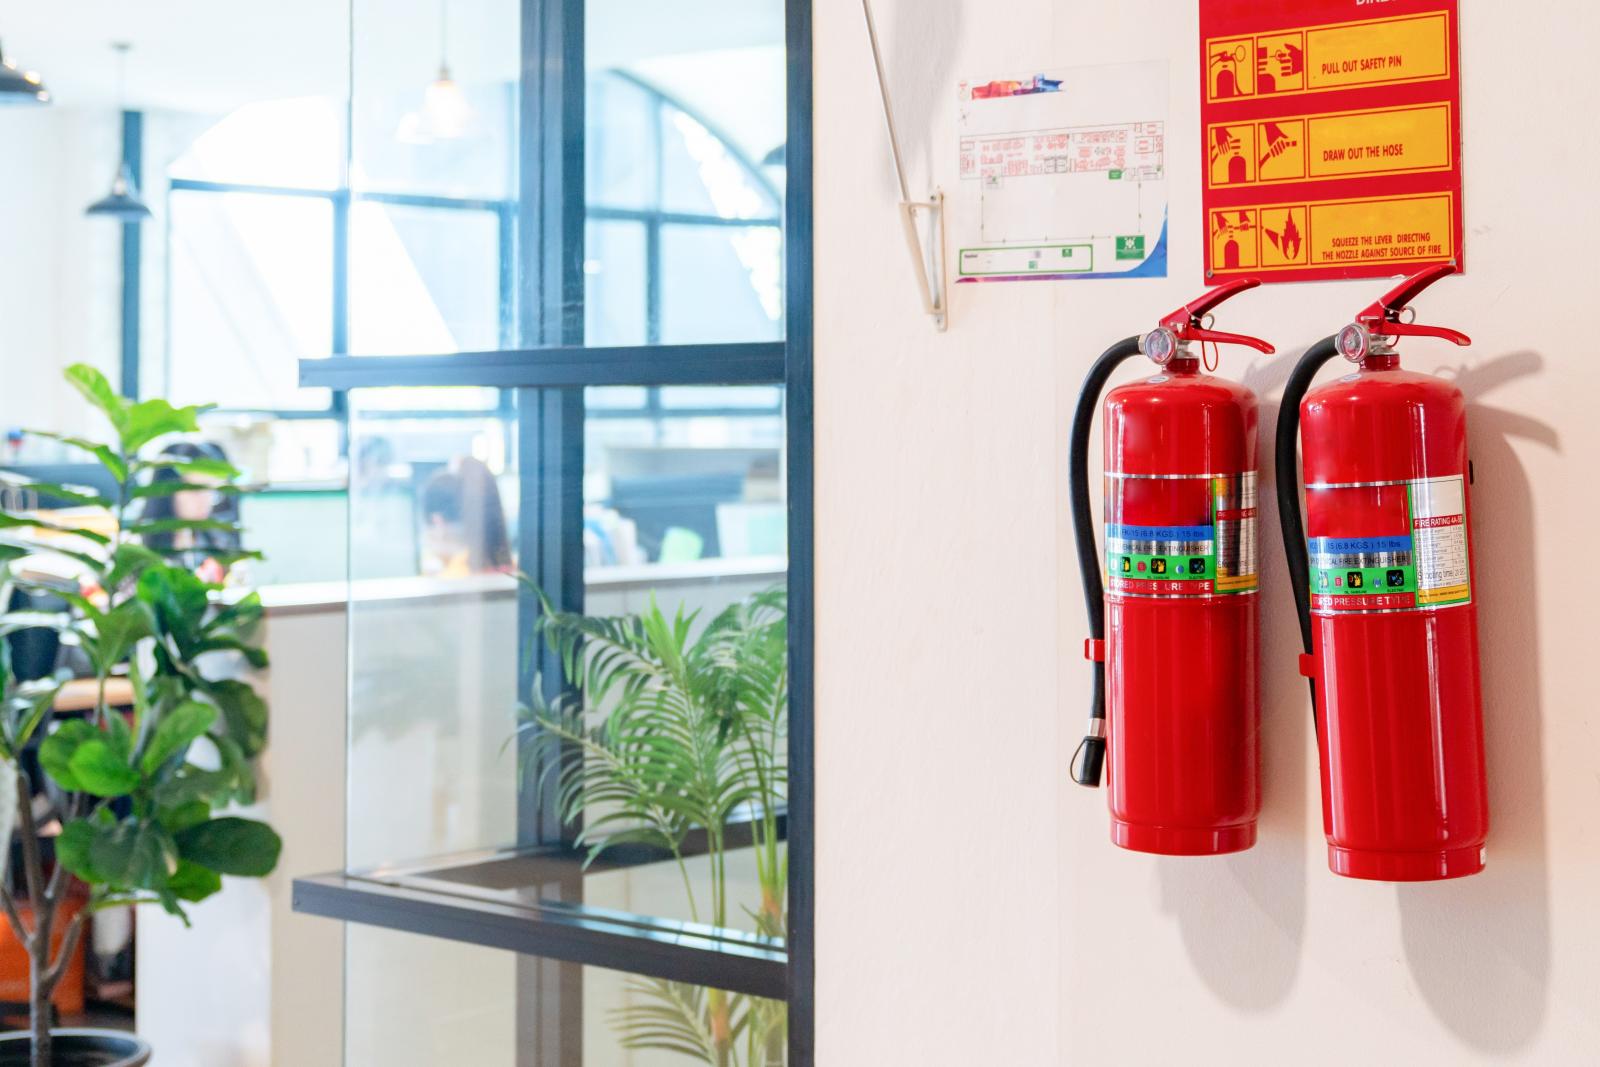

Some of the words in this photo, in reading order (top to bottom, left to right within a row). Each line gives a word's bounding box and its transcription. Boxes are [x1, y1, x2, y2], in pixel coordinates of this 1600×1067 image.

[1322, 63, 1340, 75] PULL
[1342, 60, 1357, 72] OUT
[1360, 57, 1386, 71] SAFETY
[1388, 55, 1402, 67] PIN
[1323, 148, 1345, 162] DRAW
[1347, 146, 1363, 160] OUT
[1366, 145, 1380, 158] THE
[1382, 144, 1403, 157] HOSE
[1332, 237, 1358, 248] SQUEEZE
[1360, 236, 1372, 245] THE
[1375, 235, 1392, 245] LEVER
[1397, 232, 1430, 243] DIRECTING
[1322, 251, 1333, 260] THE
[1336, 249, 1358, 260] NOZZLE
[1361, 247, 1388, 258] AGAINST
[1390, 246, 1415, 256] SOURCE
[1417, 246, 1425, 255] OF
[1428, 244, 1441, 254] FIRE
[1414, 519, 1430, 527] FIRE
[1431, 517, 1450, 526] RATING
